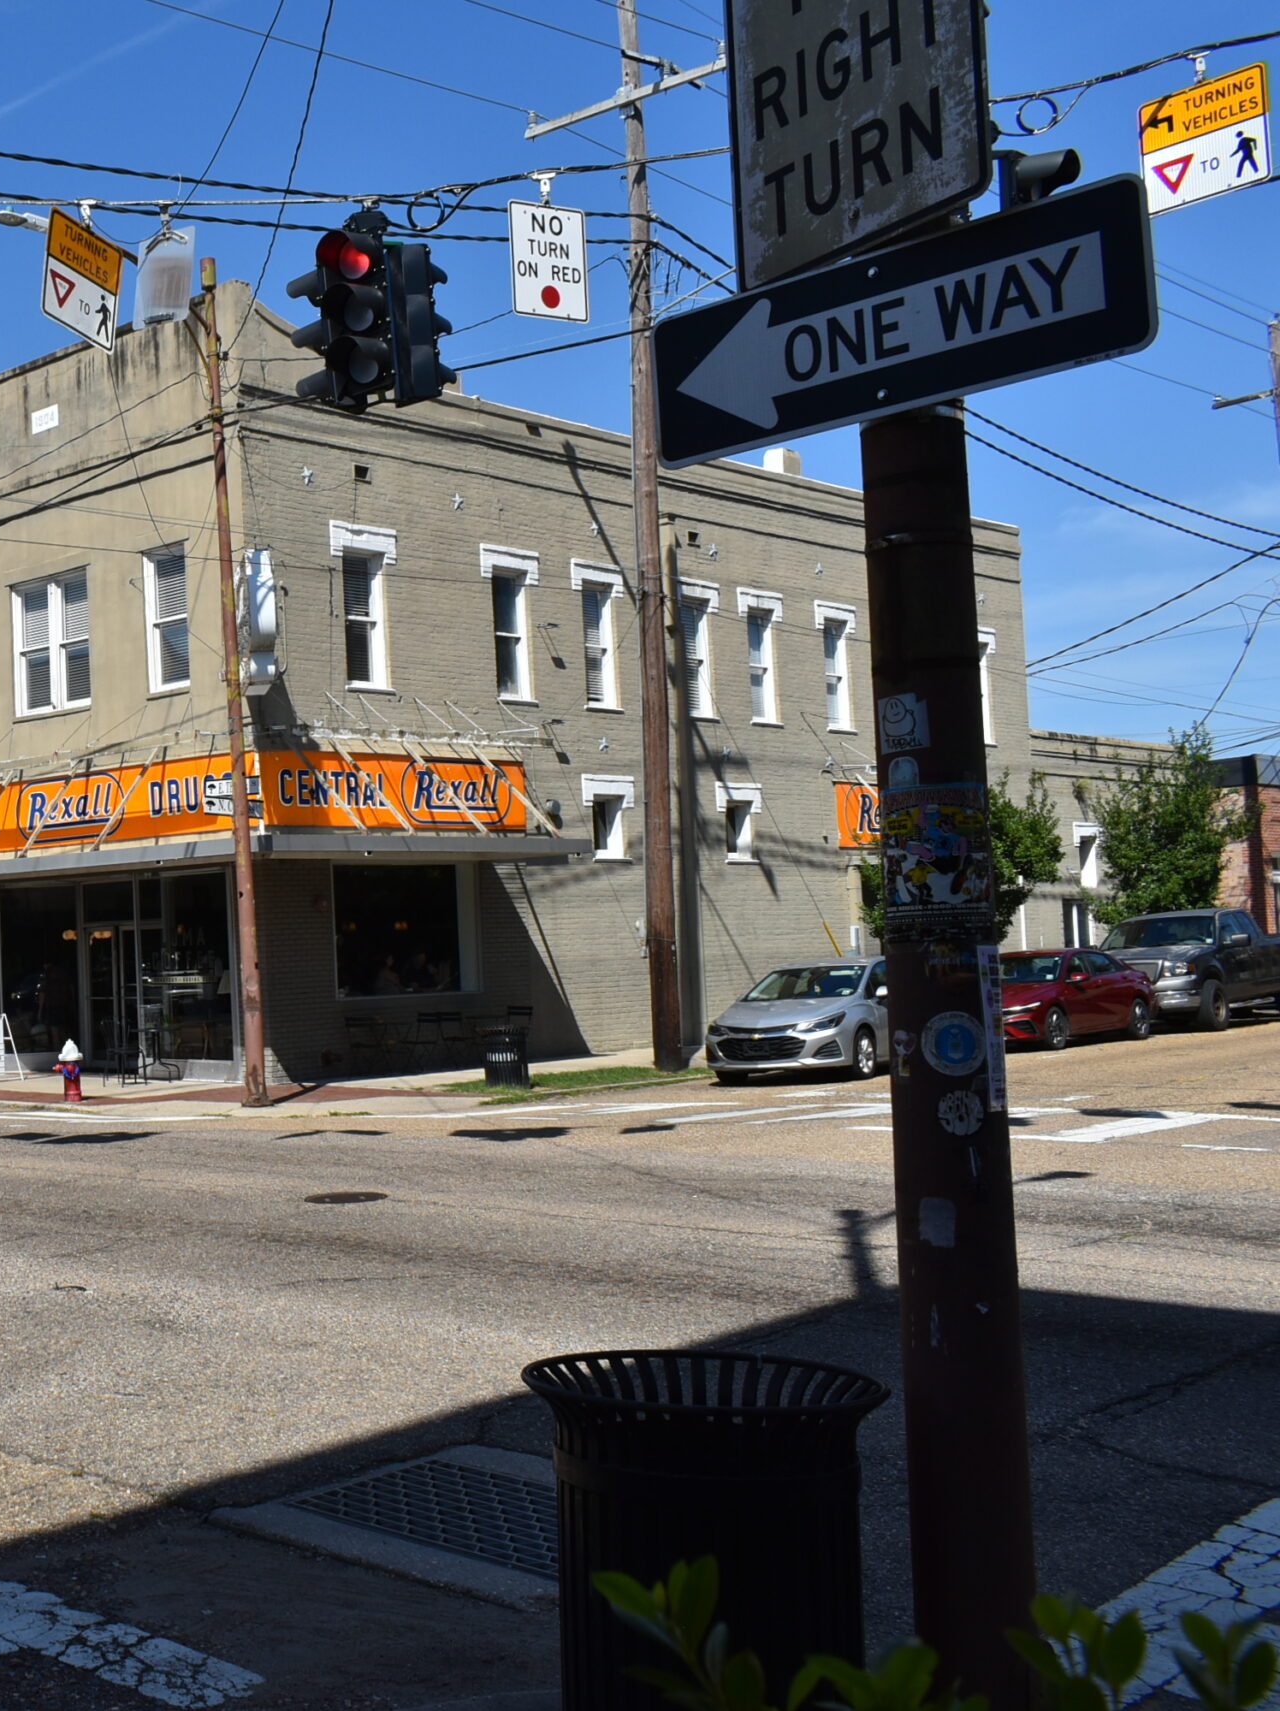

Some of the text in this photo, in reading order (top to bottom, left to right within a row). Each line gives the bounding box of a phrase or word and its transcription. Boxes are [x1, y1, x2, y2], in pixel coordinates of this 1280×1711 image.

[1184, 77, 1255, 112] TURNING
[1183, 96, 1259, 132] VEHICLES
[764, 86, 944, 236] TURN
[1200, 156, 1220, 174] TO
[531, 212, 563, 236] NO
[64, 223, 109, 262] TURNING
[528, 239, 569, 260] TURN
[59, 243, 109, 284] VEHICLES
[517, 260, 582, 285] ON RED
[79, 299, 91, 316] TO
[784, 245, 1082, 383] ONE WAY
[27, 781, 114, 832] Rexall
[149, 771, 234, 817] DRU
[278, 768, 500, 810] CENTRAL Rexall
